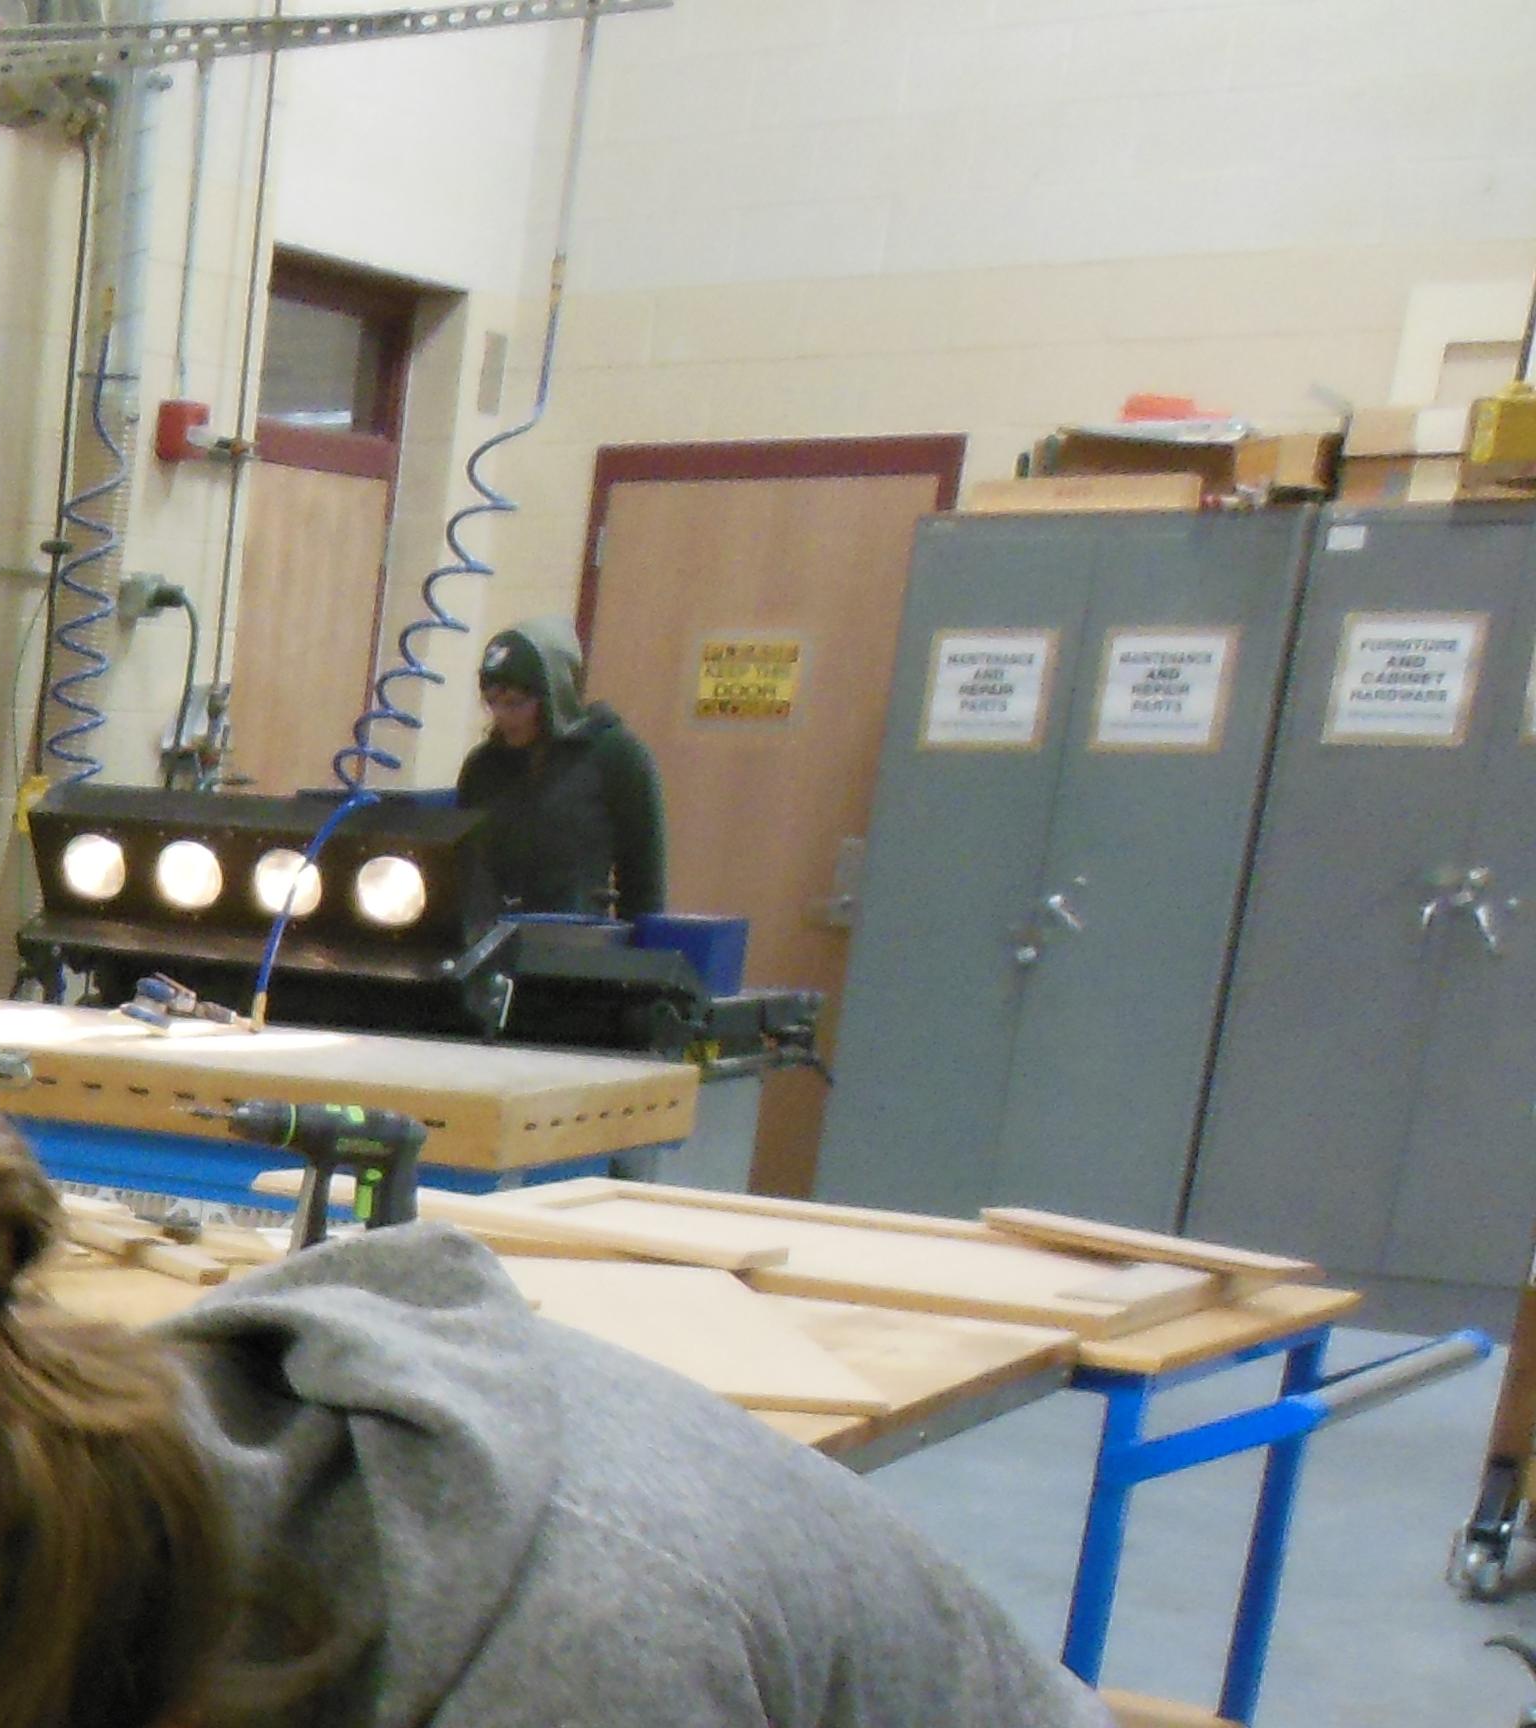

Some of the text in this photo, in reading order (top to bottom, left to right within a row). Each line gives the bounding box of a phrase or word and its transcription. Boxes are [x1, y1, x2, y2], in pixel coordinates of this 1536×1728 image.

[1360, 638, 1457, 653] FURNITURE
[947, 652, 1034, 666] MAINTENANCE
[1386, 655, 1426, 668] AND
[973, 669, 1005, 680] AND
[1147, 667, 1181, 680] AND
[1360, 671, 1446, 685] CABINET
[958, 683, 1015, 696] REPAIR
[1131, 683, 1190, 696] REPAIR
[1349, 689, 1448, 703] HARDWARE
[959, 699, 1007, 713] PARTS
[1130, 699, 1182, 713] PARTS
